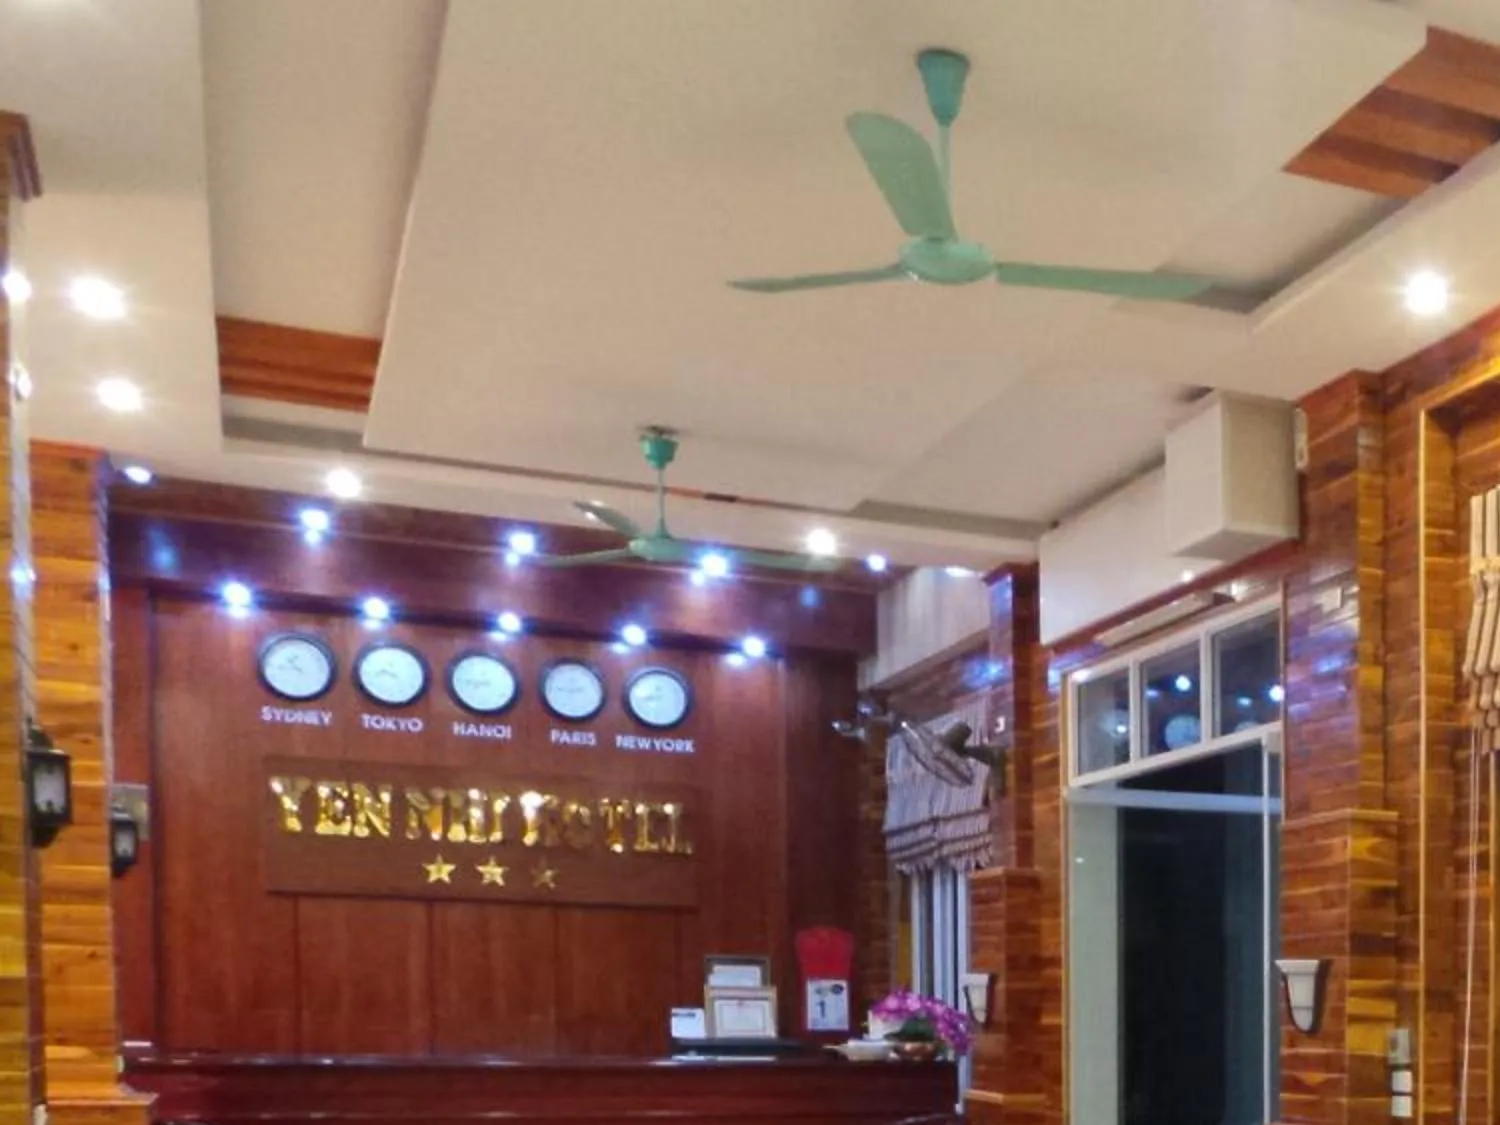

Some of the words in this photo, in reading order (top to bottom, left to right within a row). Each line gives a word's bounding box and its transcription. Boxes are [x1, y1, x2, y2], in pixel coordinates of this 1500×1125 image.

[261, 705, 332, 726] SYDNEY
[361, 713, 424, 733] TOKYO
[453, 721, 512, 740] HANOI
[551, 728, 597, 747] PARIS
[269, 776, 393, 838] YEN
